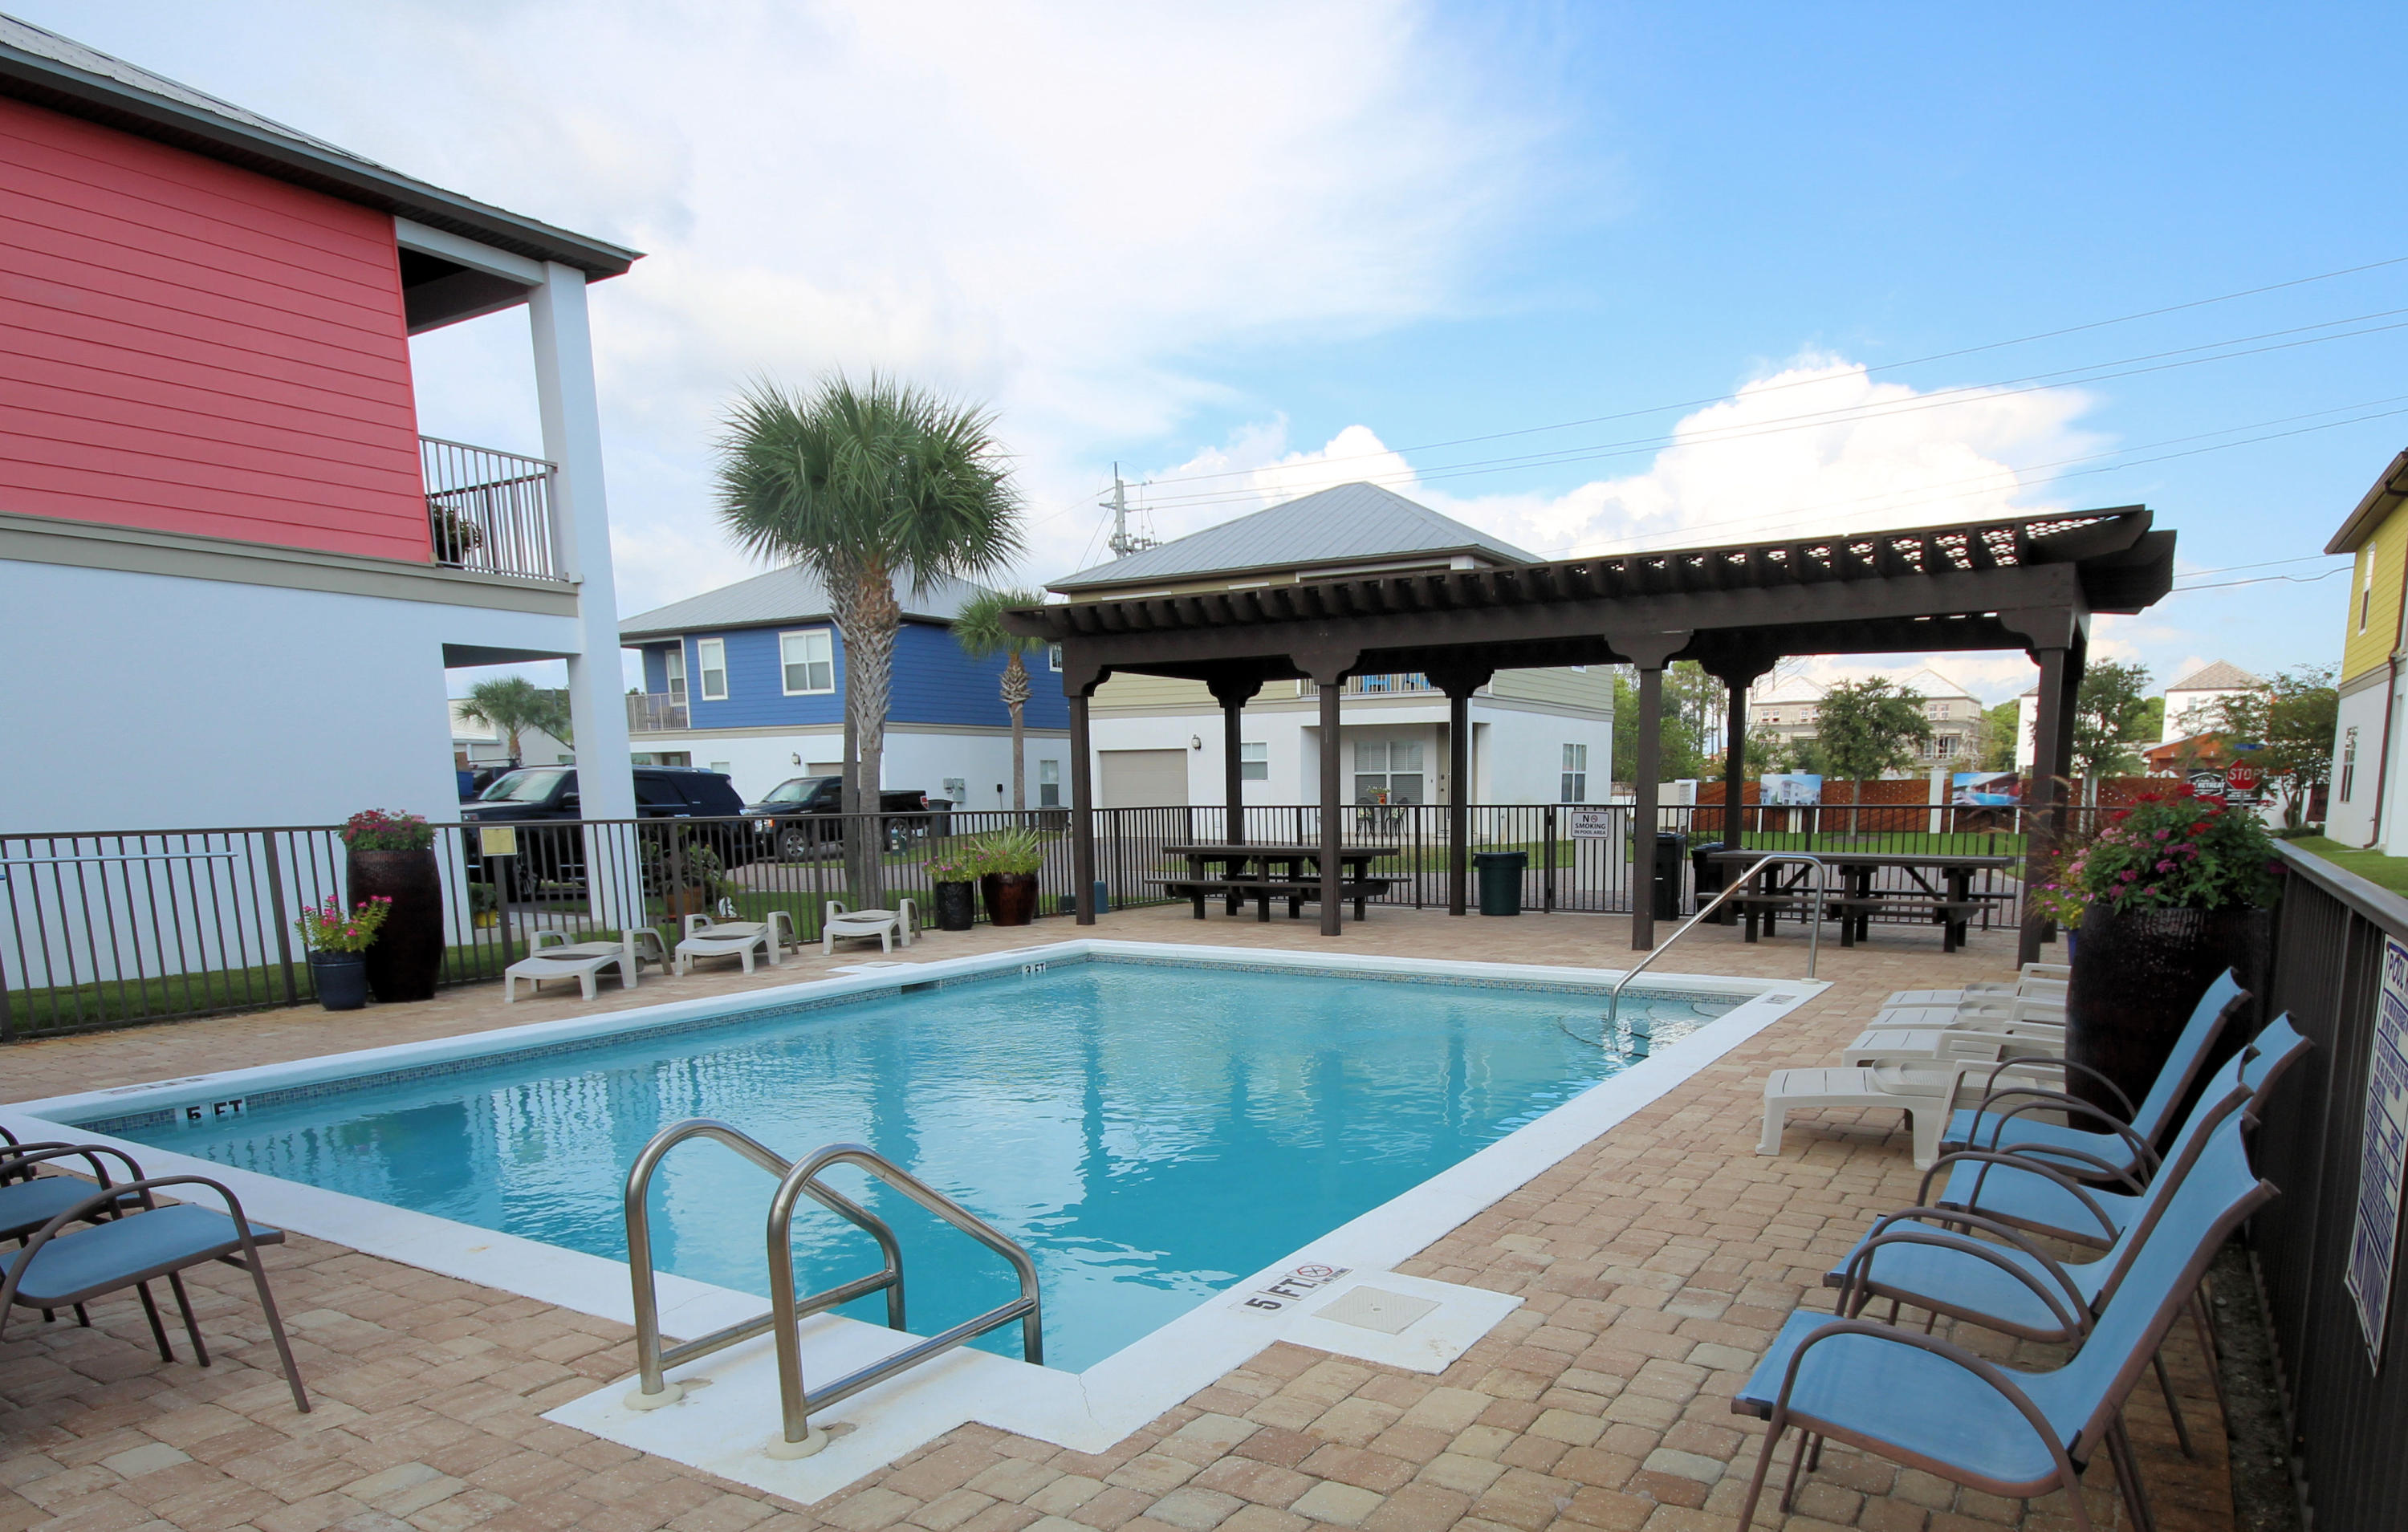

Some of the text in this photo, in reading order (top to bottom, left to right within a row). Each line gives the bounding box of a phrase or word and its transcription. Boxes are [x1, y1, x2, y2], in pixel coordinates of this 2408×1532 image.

[2229, 768, 2261, 780] STOP
[1035, 963, 1045, 973] FT
[2387, 952, 2405, 990] POOL
[186, 1099, 242, 1120] 5 FT
[1243, 1297, 1283, 1311] 5
